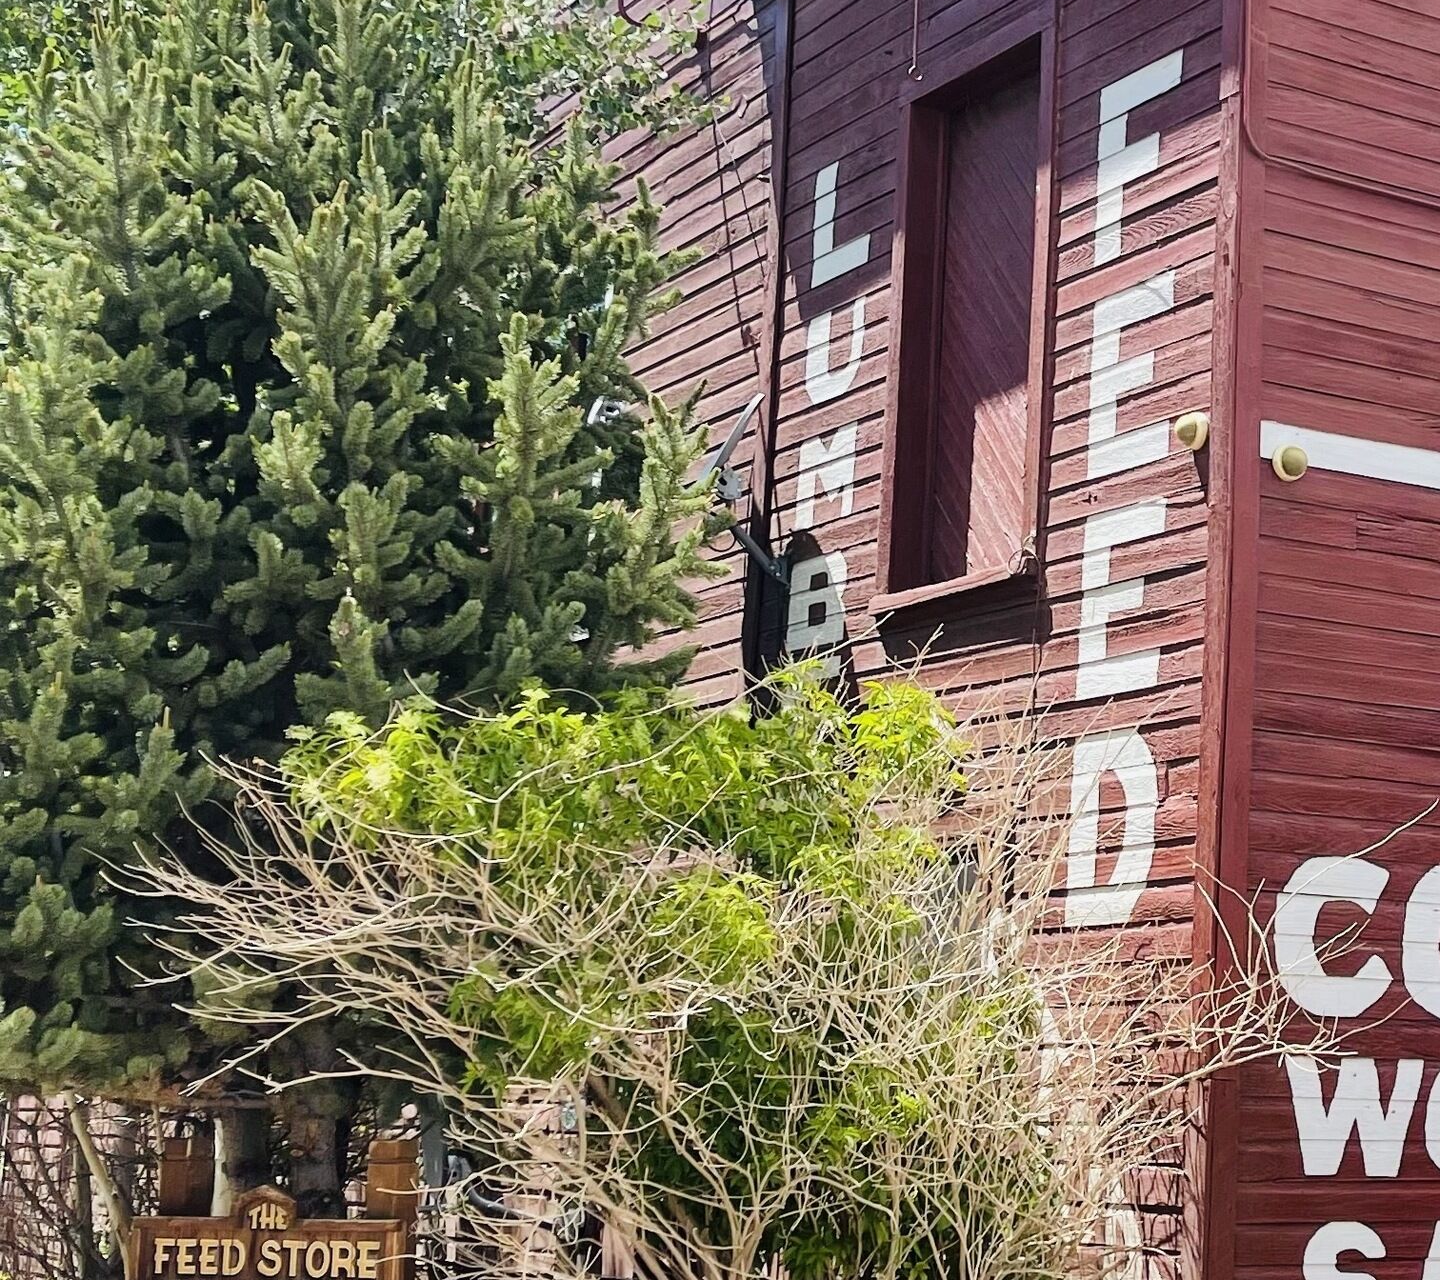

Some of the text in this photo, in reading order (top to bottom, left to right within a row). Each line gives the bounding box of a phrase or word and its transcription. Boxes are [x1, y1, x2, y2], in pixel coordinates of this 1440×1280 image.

[784, 160, 872, 678] LUMB
[1064, 48, 1184, 924] FEED
[153, 1237, 381, 1280] FEED STORE
[248, 1204, 289, 1231] THE
